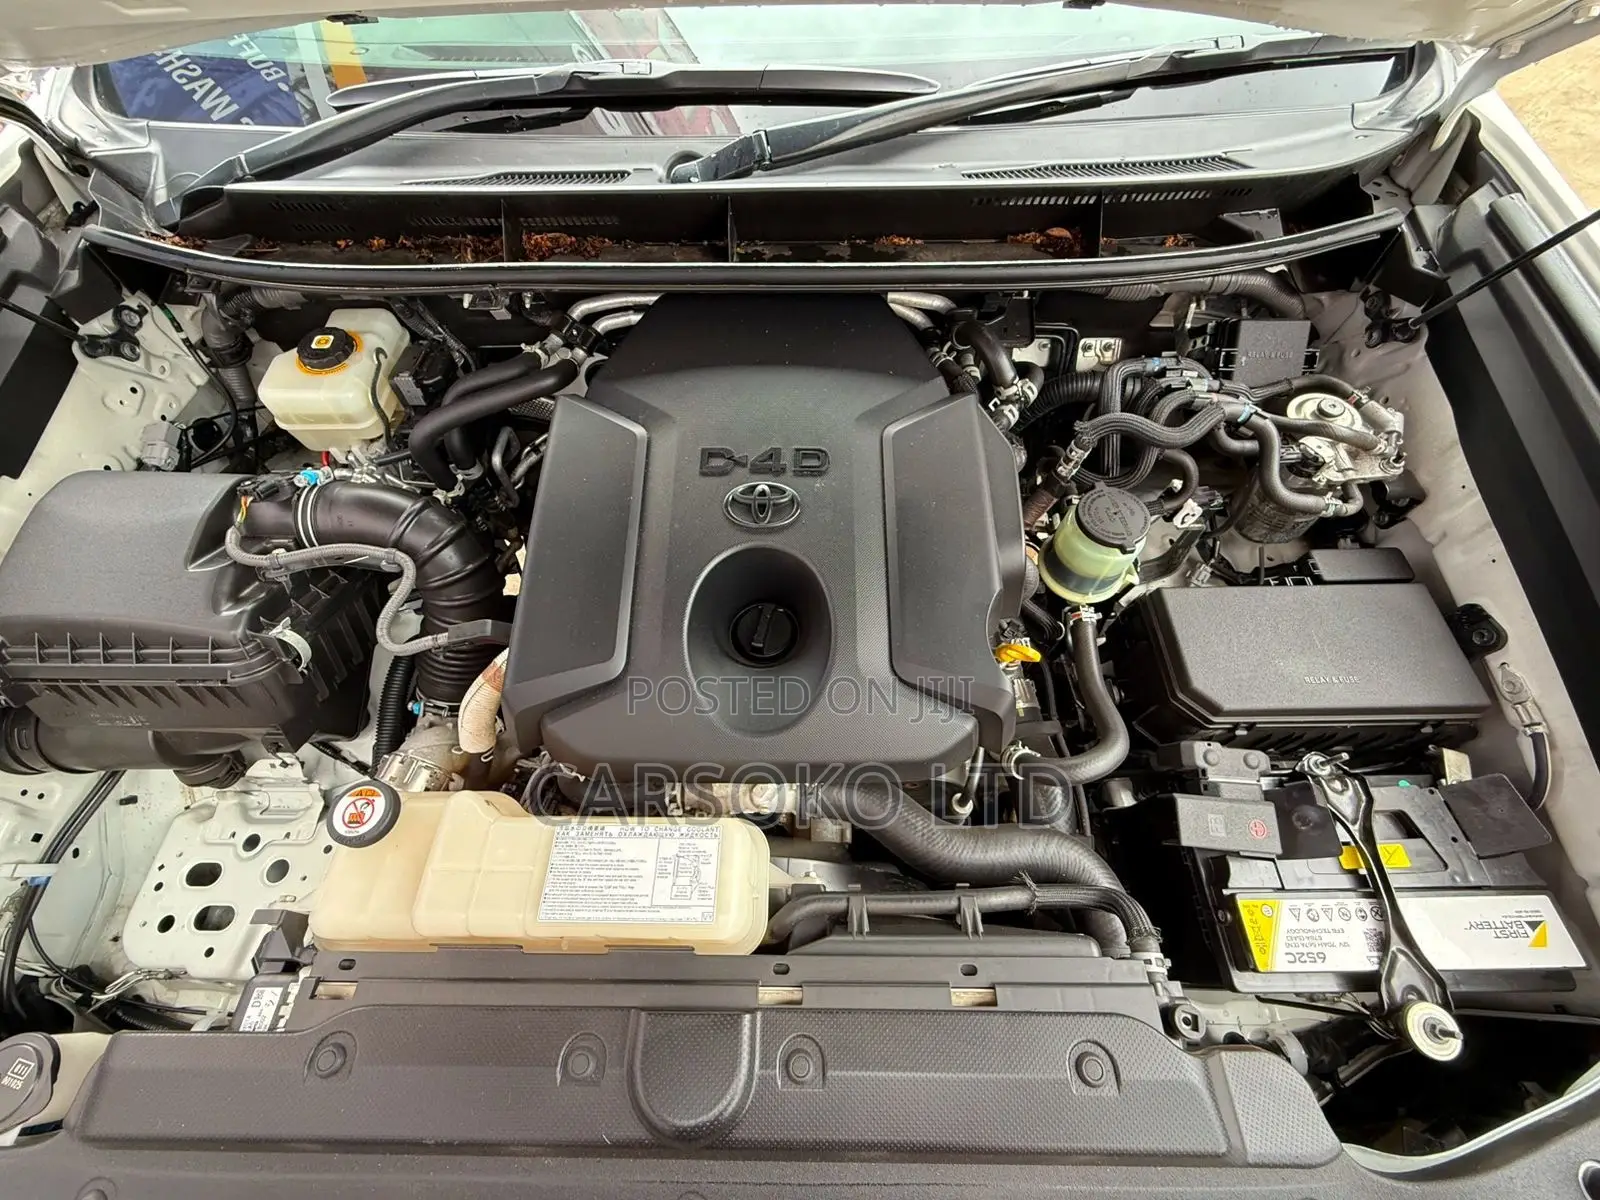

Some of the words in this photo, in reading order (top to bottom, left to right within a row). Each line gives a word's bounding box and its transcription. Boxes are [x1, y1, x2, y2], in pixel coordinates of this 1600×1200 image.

[1303, 676, 1329, 684] RELAY
[1468, 920, 1525, 930] BATTERY
[1493, 929, 1530, 939] FIRST
[1284, 952, 1327, 964] 652C
